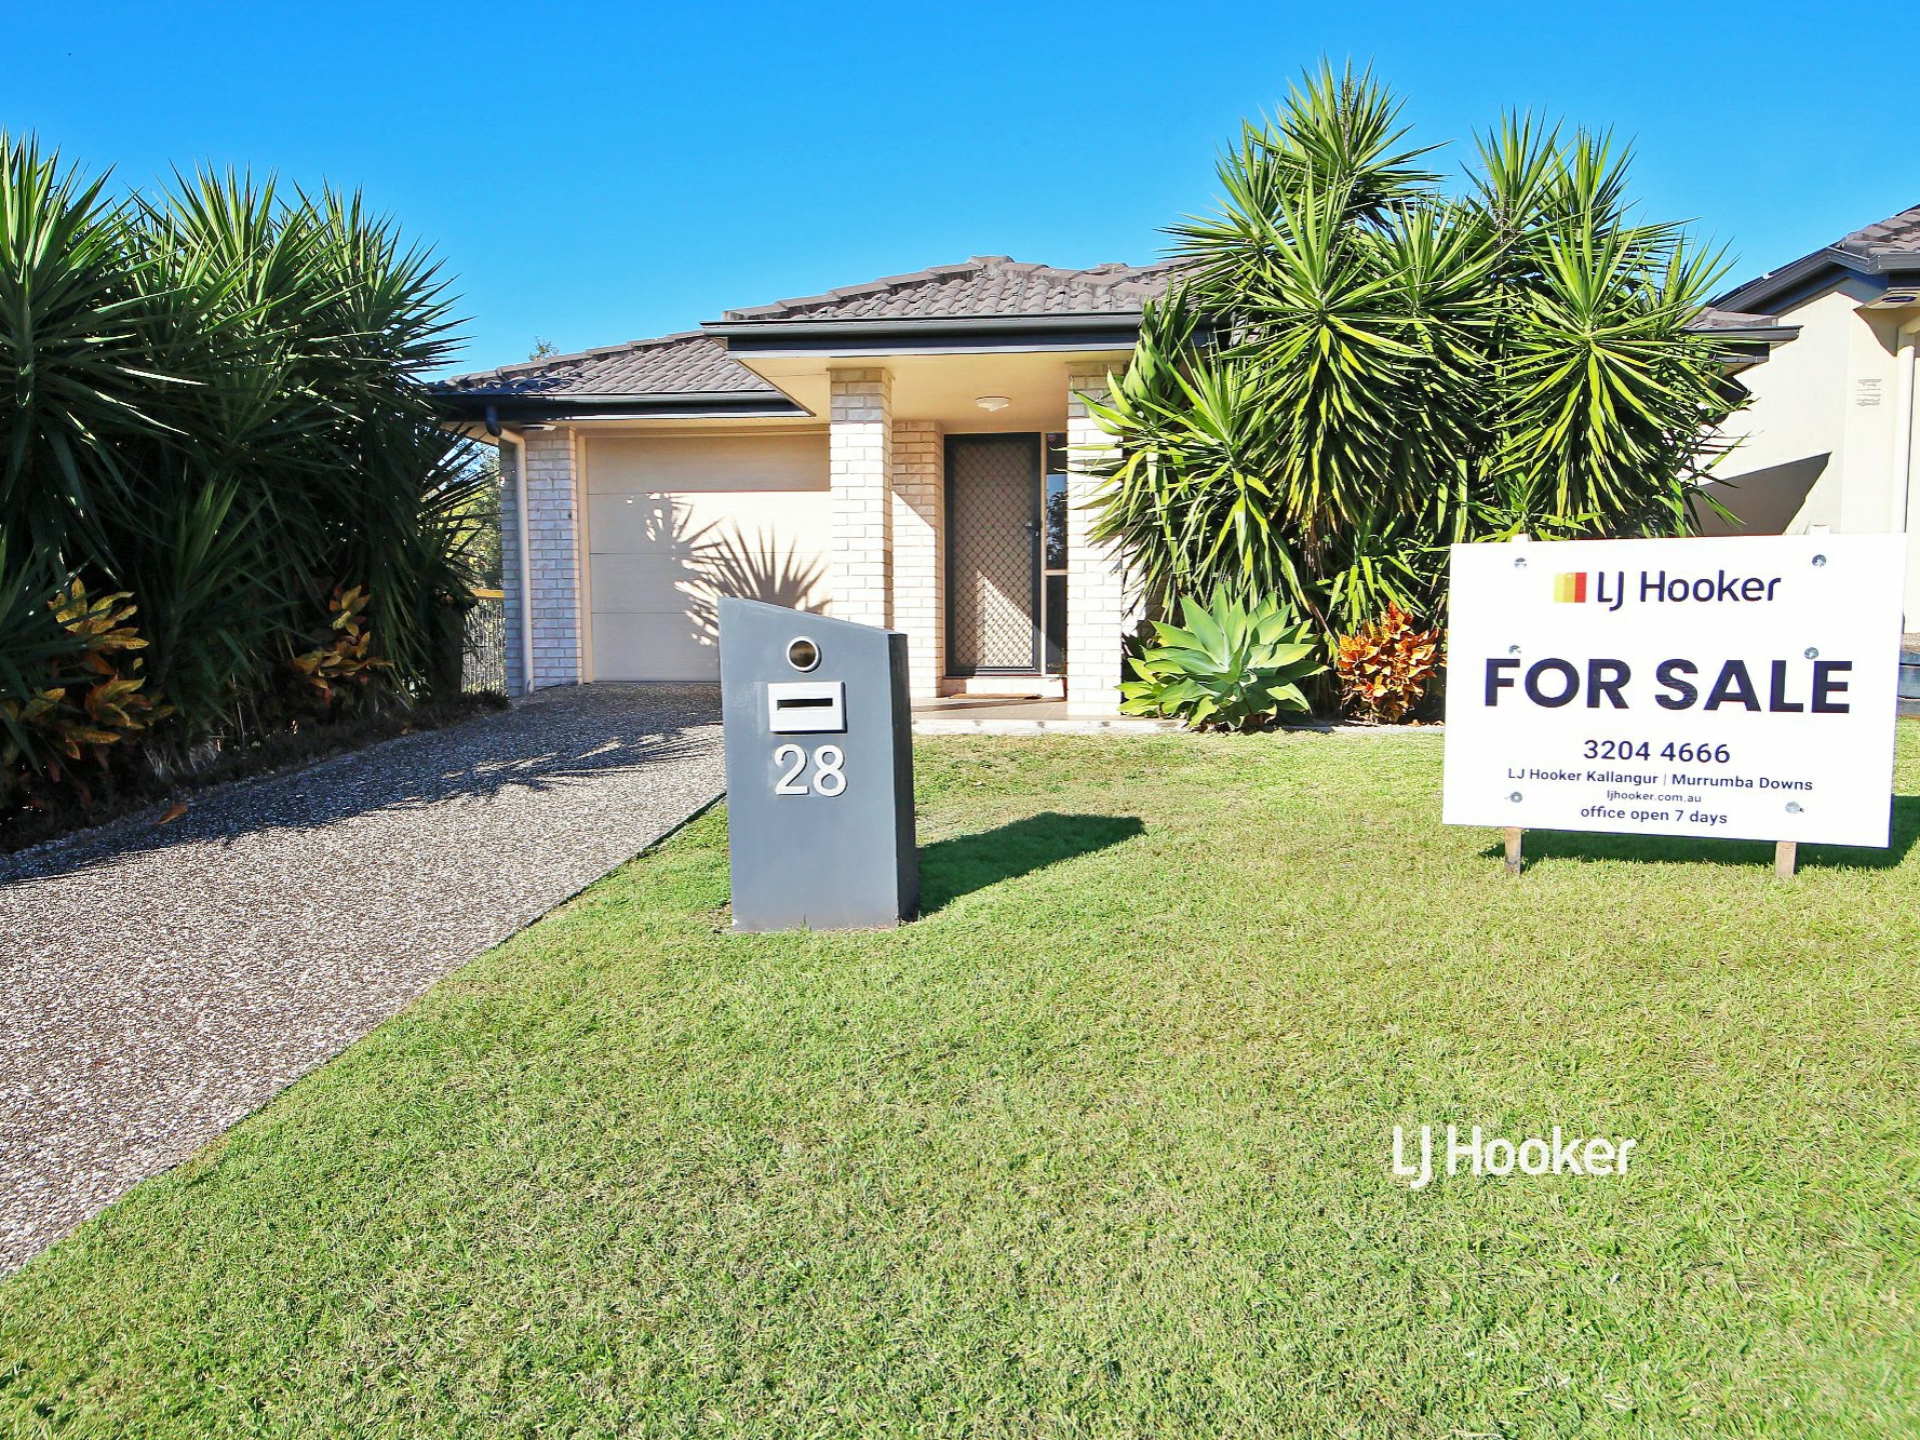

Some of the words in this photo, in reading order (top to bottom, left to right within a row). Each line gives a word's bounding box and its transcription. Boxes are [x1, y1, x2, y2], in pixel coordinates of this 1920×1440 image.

[1596, 571, 1625, 612] LJ
[1640, 569, 1782, 603] Hooker
[1484, 657, 1632, 710] FOR
[1654, 658, 1853, 714] SALE
[1583, 739, 1651, 761] 3204
[1660, 741, 1731, 764] 4666
[773, 743, 847, 797] 28
[1508, 768, 1525, 780] LJ
[1529, 768, 1582, 782] Hooker
[1586, 770, 1659, 787] Kallangur
[1671, 773, 1754, 789] Murrumba
[1759, 777, 1813, 791] Downs
[1606, 790, 1702, 803] ljhooker.com.au
[1580, 805, 1626, 819] office
[1630, 810, 1669, 823] open
[1675, 809, 1684, 822] 7
[1689, 810, 1728, 826] days
